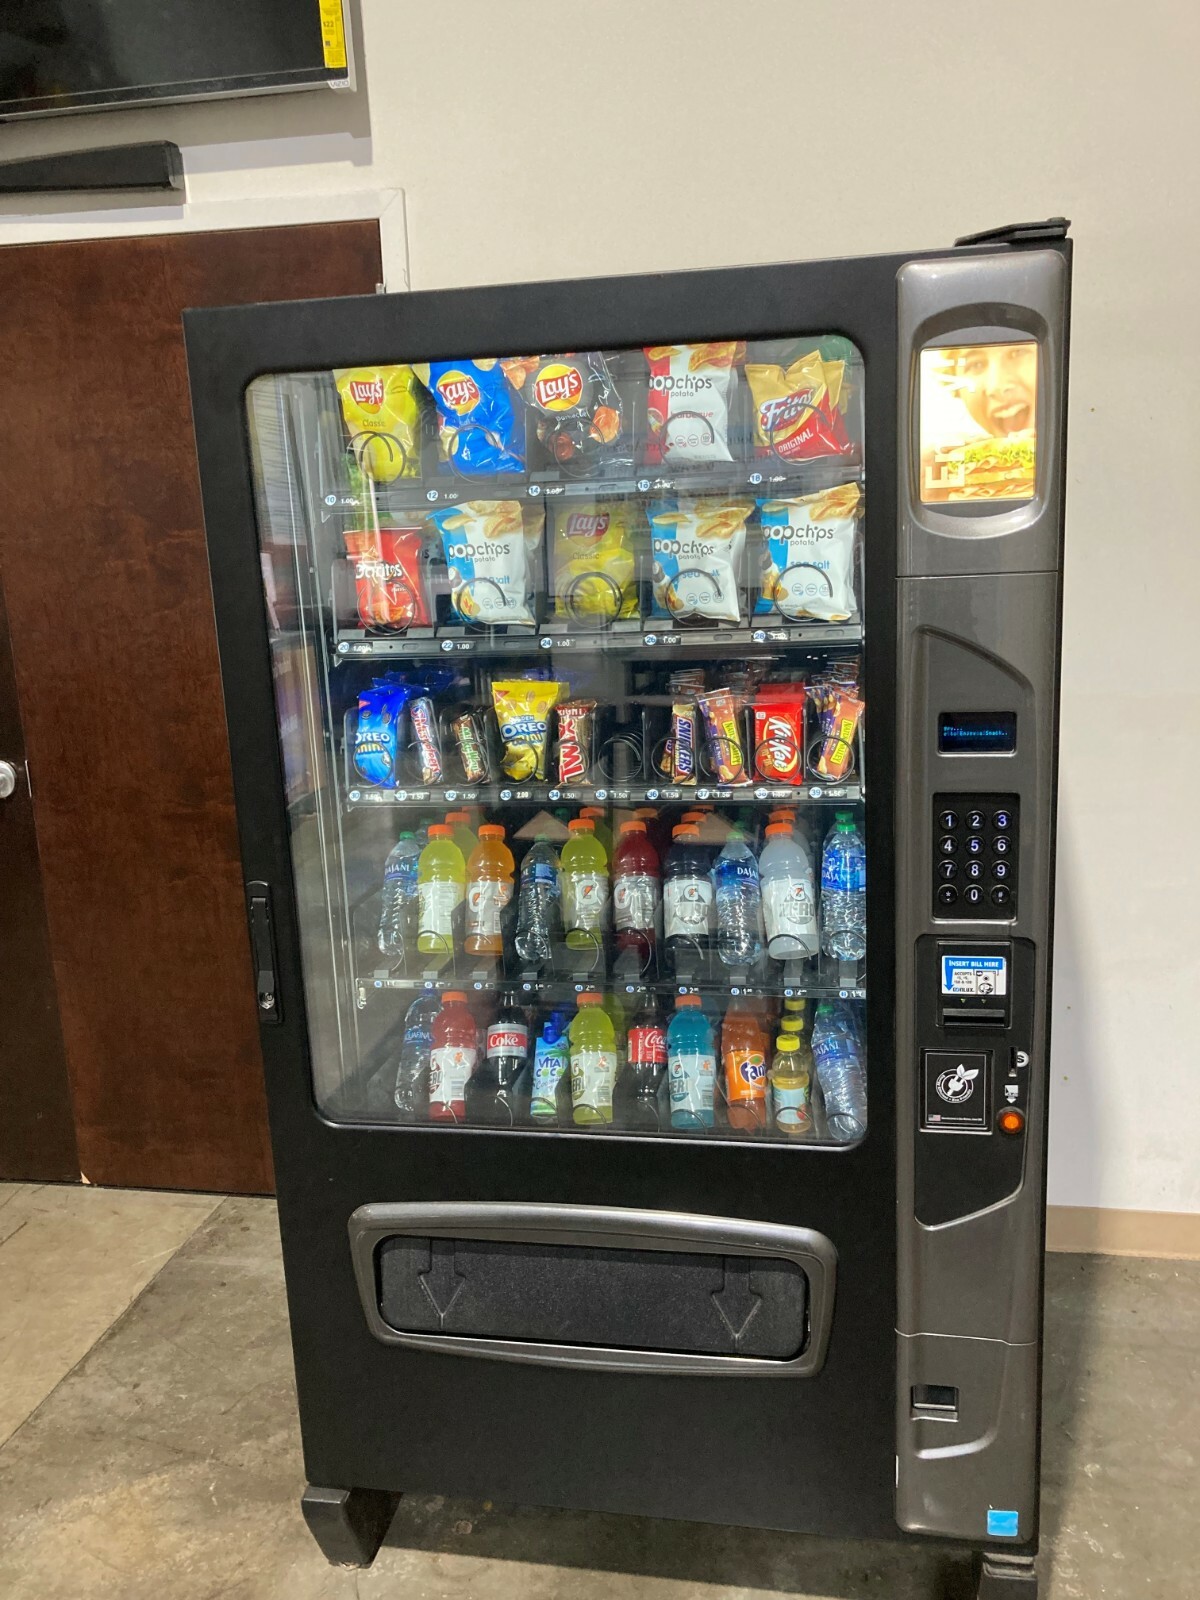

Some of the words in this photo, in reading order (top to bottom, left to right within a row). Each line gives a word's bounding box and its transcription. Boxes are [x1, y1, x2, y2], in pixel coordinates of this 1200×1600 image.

[353, 379, 384, 404] Lay's
[538, 371, 580, 403] Lay's
[778, 428, 814, 453] ORIGINAL
[569, 512, 606, 537] Lay's
[653, 538, 715, 561] popchips
[501, 721, 547, 738] OREO
[558, 719, 584, 784] TWIX
[945, 815, 952, 826] 1
[972, 815, 980, 826] 2
[997, 815, 1007, 826] 3
[944, 840, 952, 851] 4
[970, 840, 979, 851] 5
[997, 840, 1006, 851] 6
[945, 864, 953, 876] 7
[971, 864, 979, 876] 8
[997, 864, 1006, 876] 9
[970, 889, 978, 901] 0
[948, 959, 969, 967] INSERT
[490, 1034, 519, 1048] Coke
[538, 1056, 561, 1068] VITA
